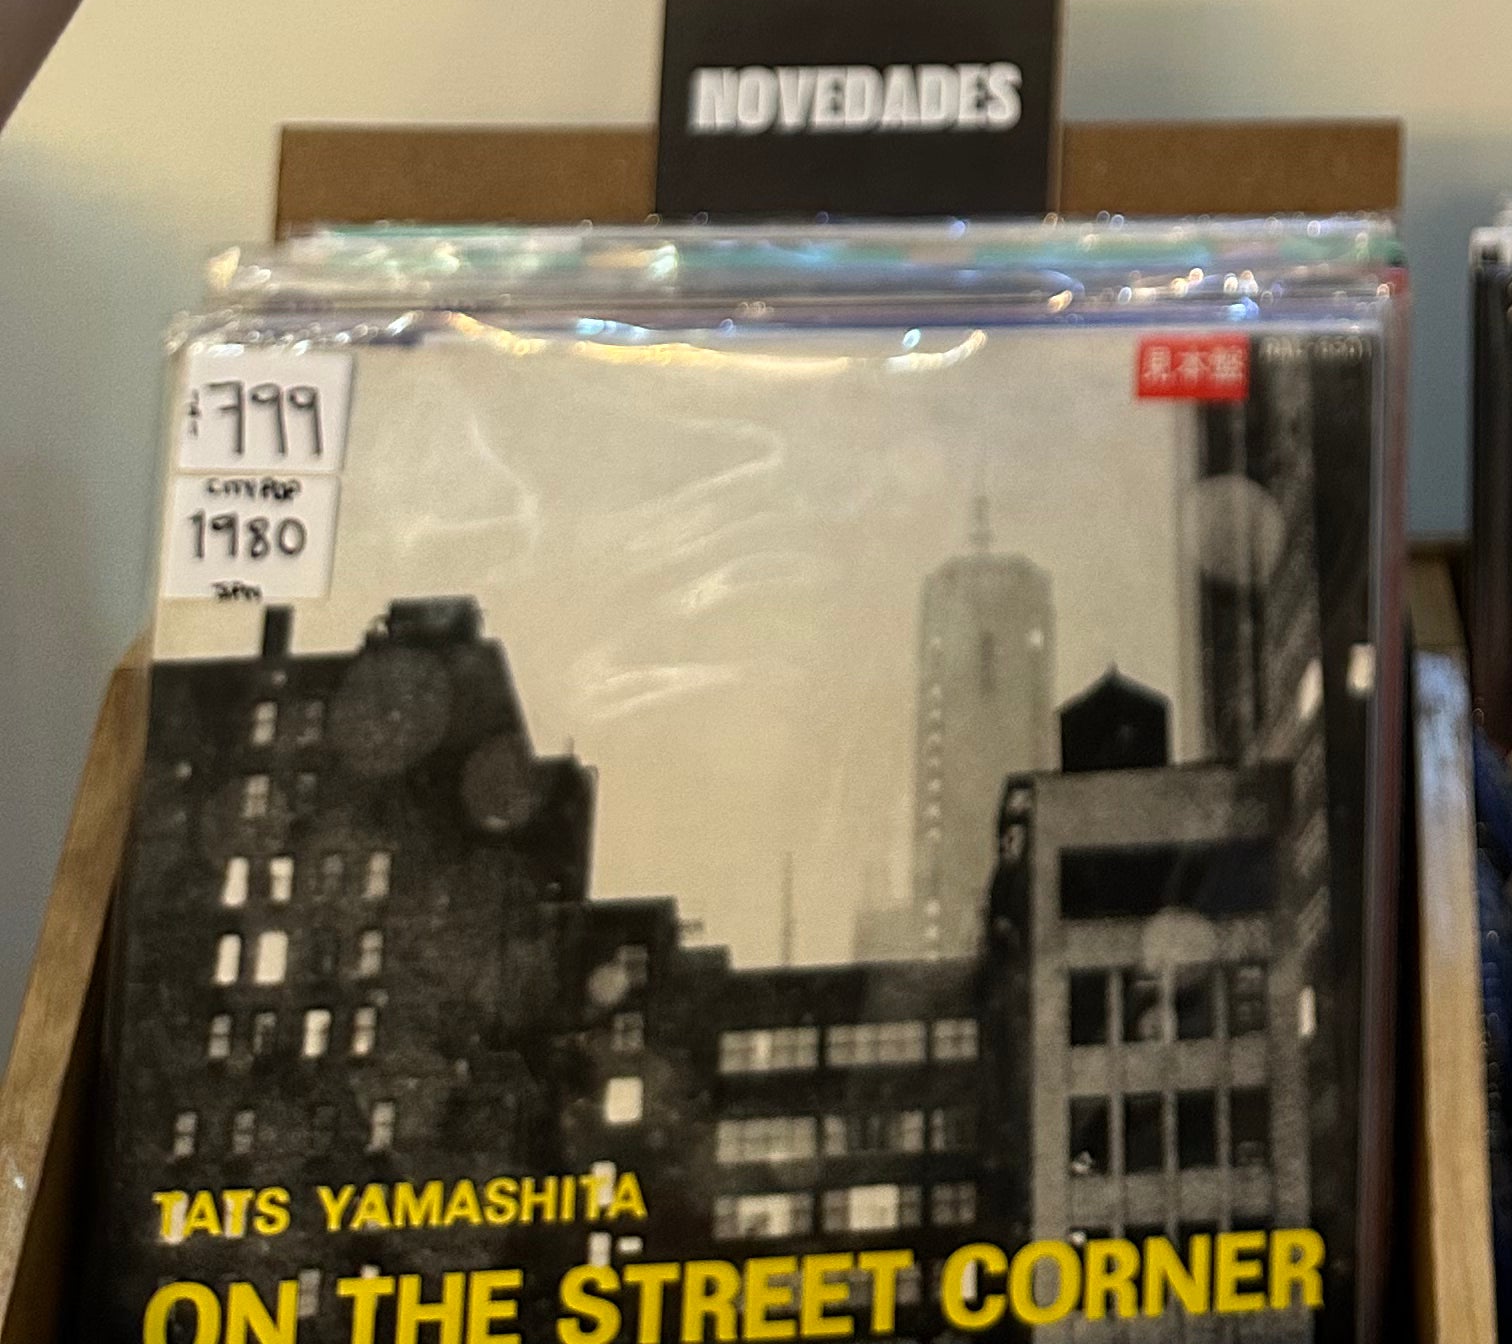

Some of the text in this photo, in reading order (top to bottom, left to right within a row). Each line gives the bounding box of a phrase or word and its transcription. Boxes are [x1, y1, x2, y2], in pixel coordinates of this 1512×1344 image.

[689, 60, 1023, 135] NOVEDADES
[187, 508, 307, 560] 1980
[153, 1169, 648, 1243] TATS YAMASHITA
[142, 1227, 1328, 1344] ON THE STREET CORNER
